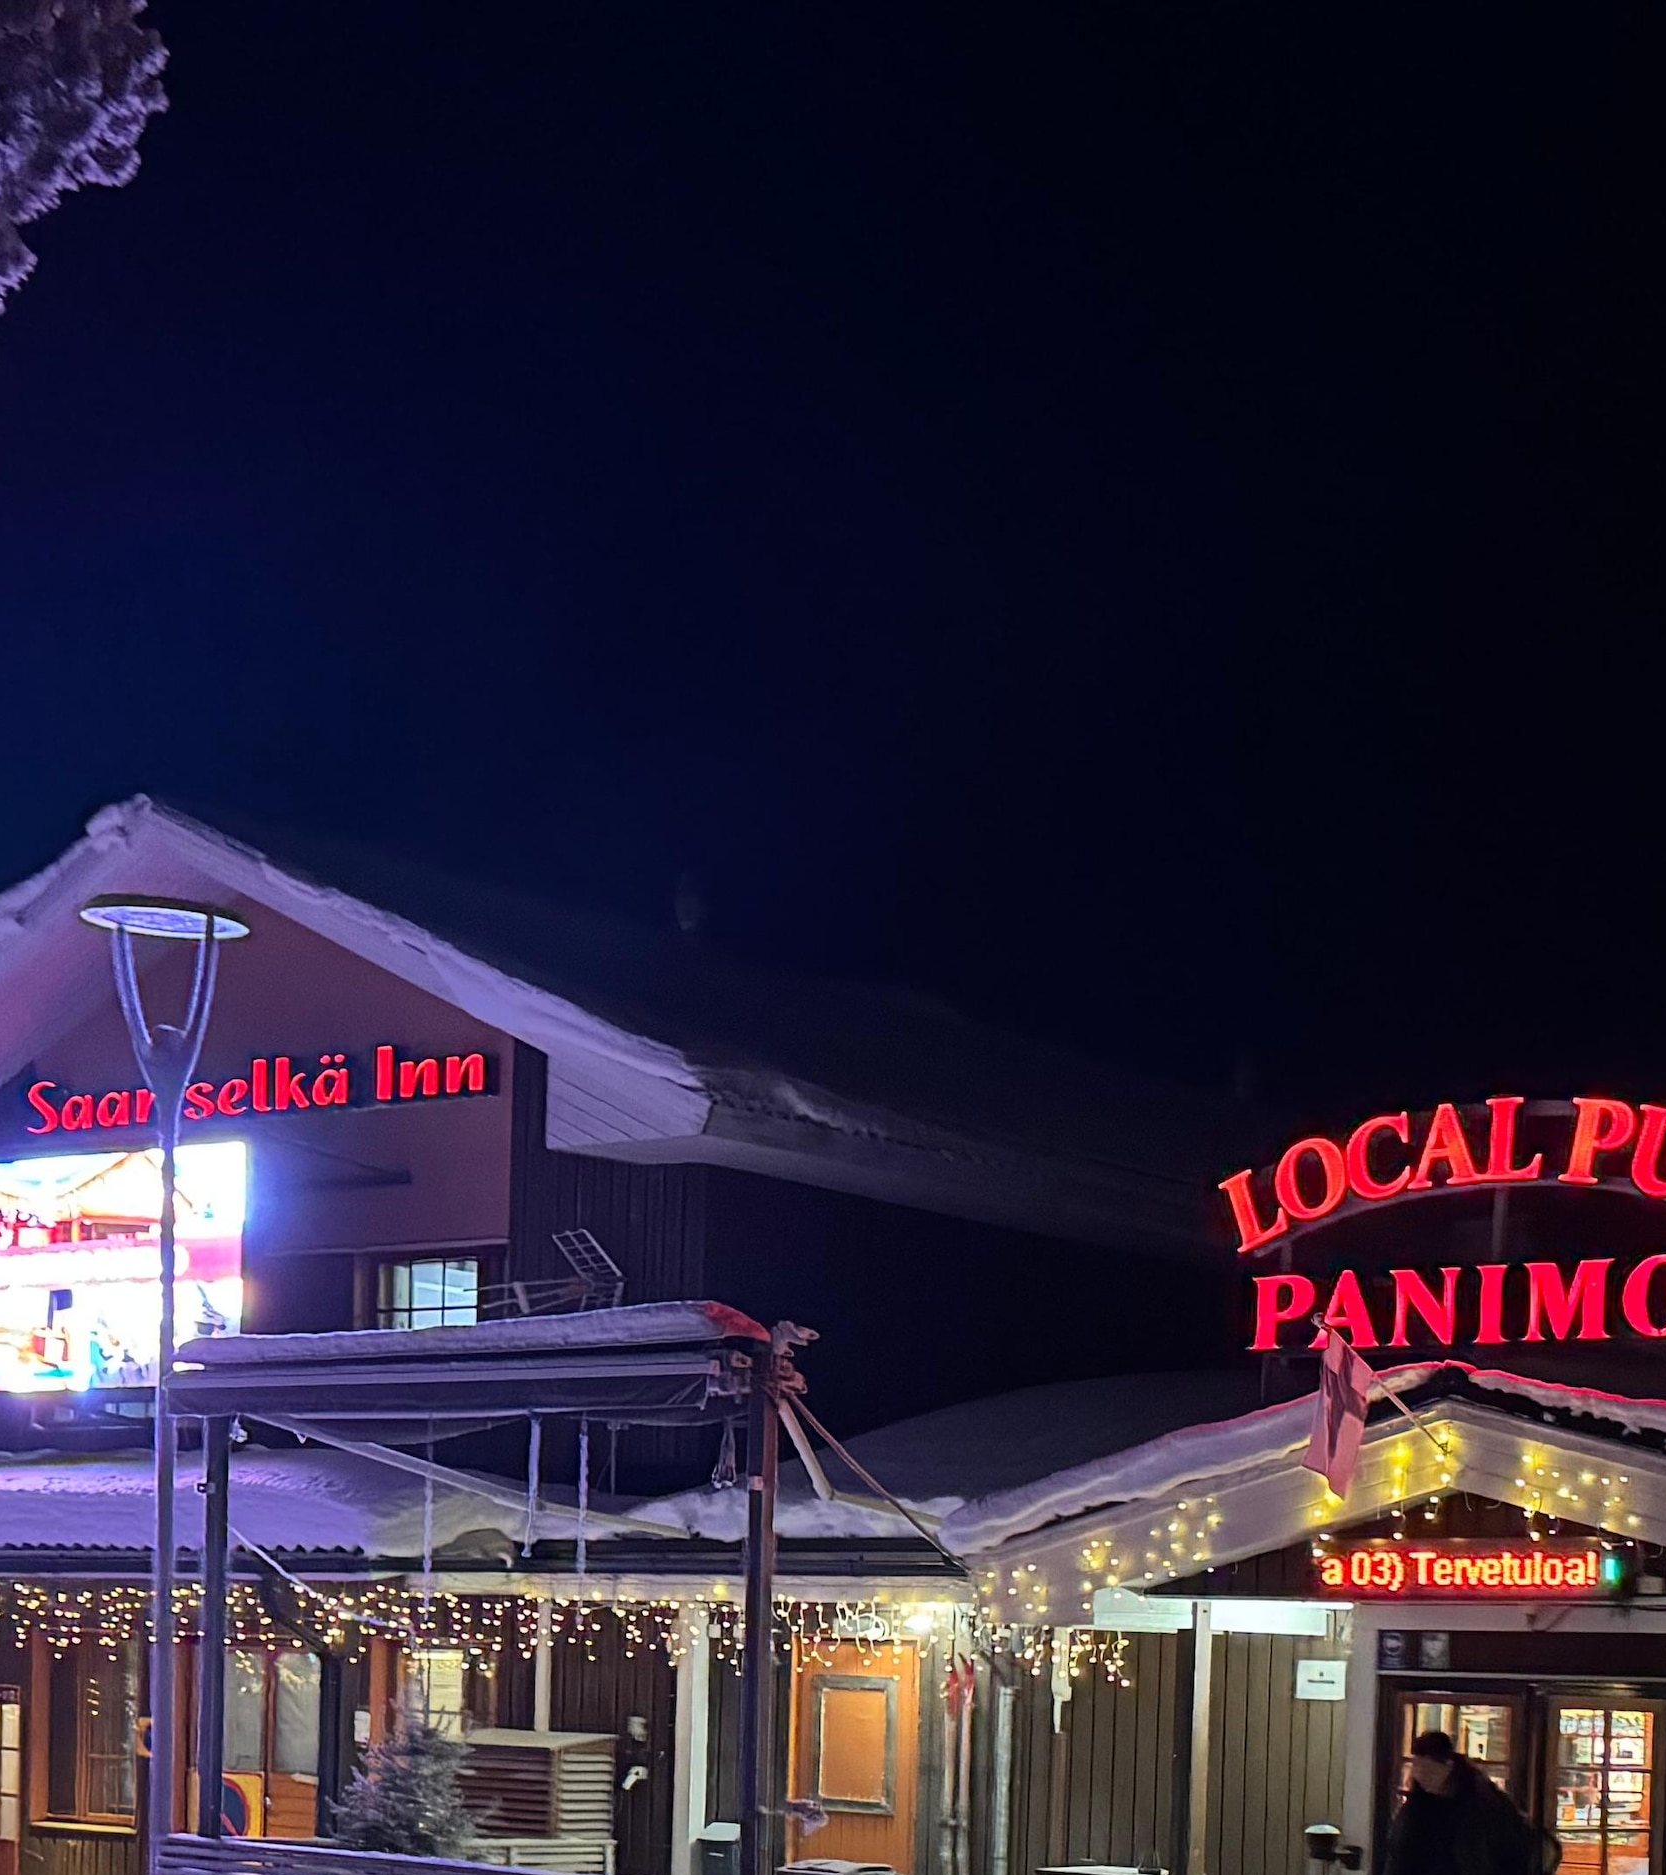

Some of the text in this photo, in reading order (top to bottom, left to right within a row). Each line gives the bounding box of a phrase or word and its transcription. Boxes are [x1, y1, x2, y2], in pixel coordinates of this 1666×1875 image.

[26, 1045, 485, 1135] Saarselkä Inn
[1218, 1096, 1544, 1254] LOCAL
[1408, 1551, 1599, 1587] Tervetuloa!
